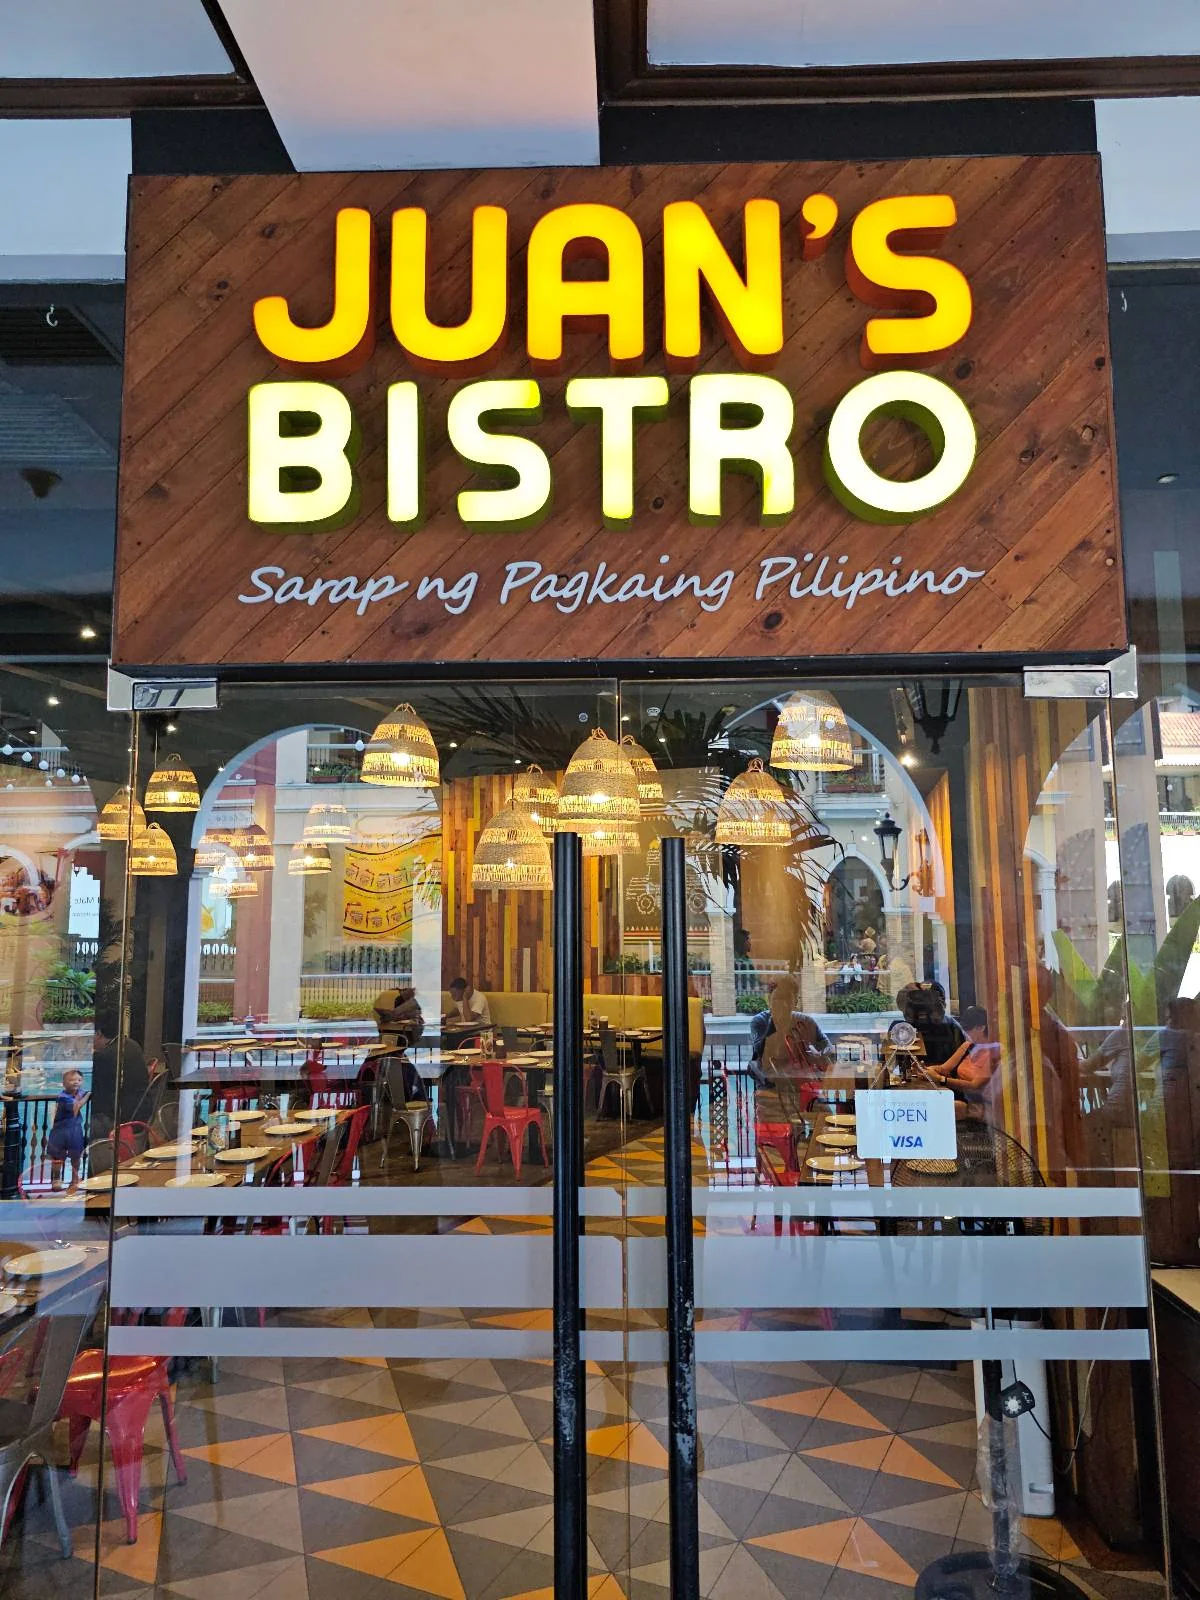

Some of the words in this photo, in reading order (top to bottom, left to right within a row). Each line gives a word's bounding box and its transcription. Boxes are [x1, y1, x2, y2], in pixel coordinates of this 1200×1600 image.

[252, 193, 972, 364] JUAN'S
[248, 370, 977, 523] BISTRO
[237, 565, 410, 616] Sarap
[416, 571, 479, 615] ng
[499, 554, 736, 614] Pagkaing
[754, 552, 987, 611] Pilipino
[883, 1108, 928, 1122] OPEN
[888, 1135, 924, 1149] VISA
